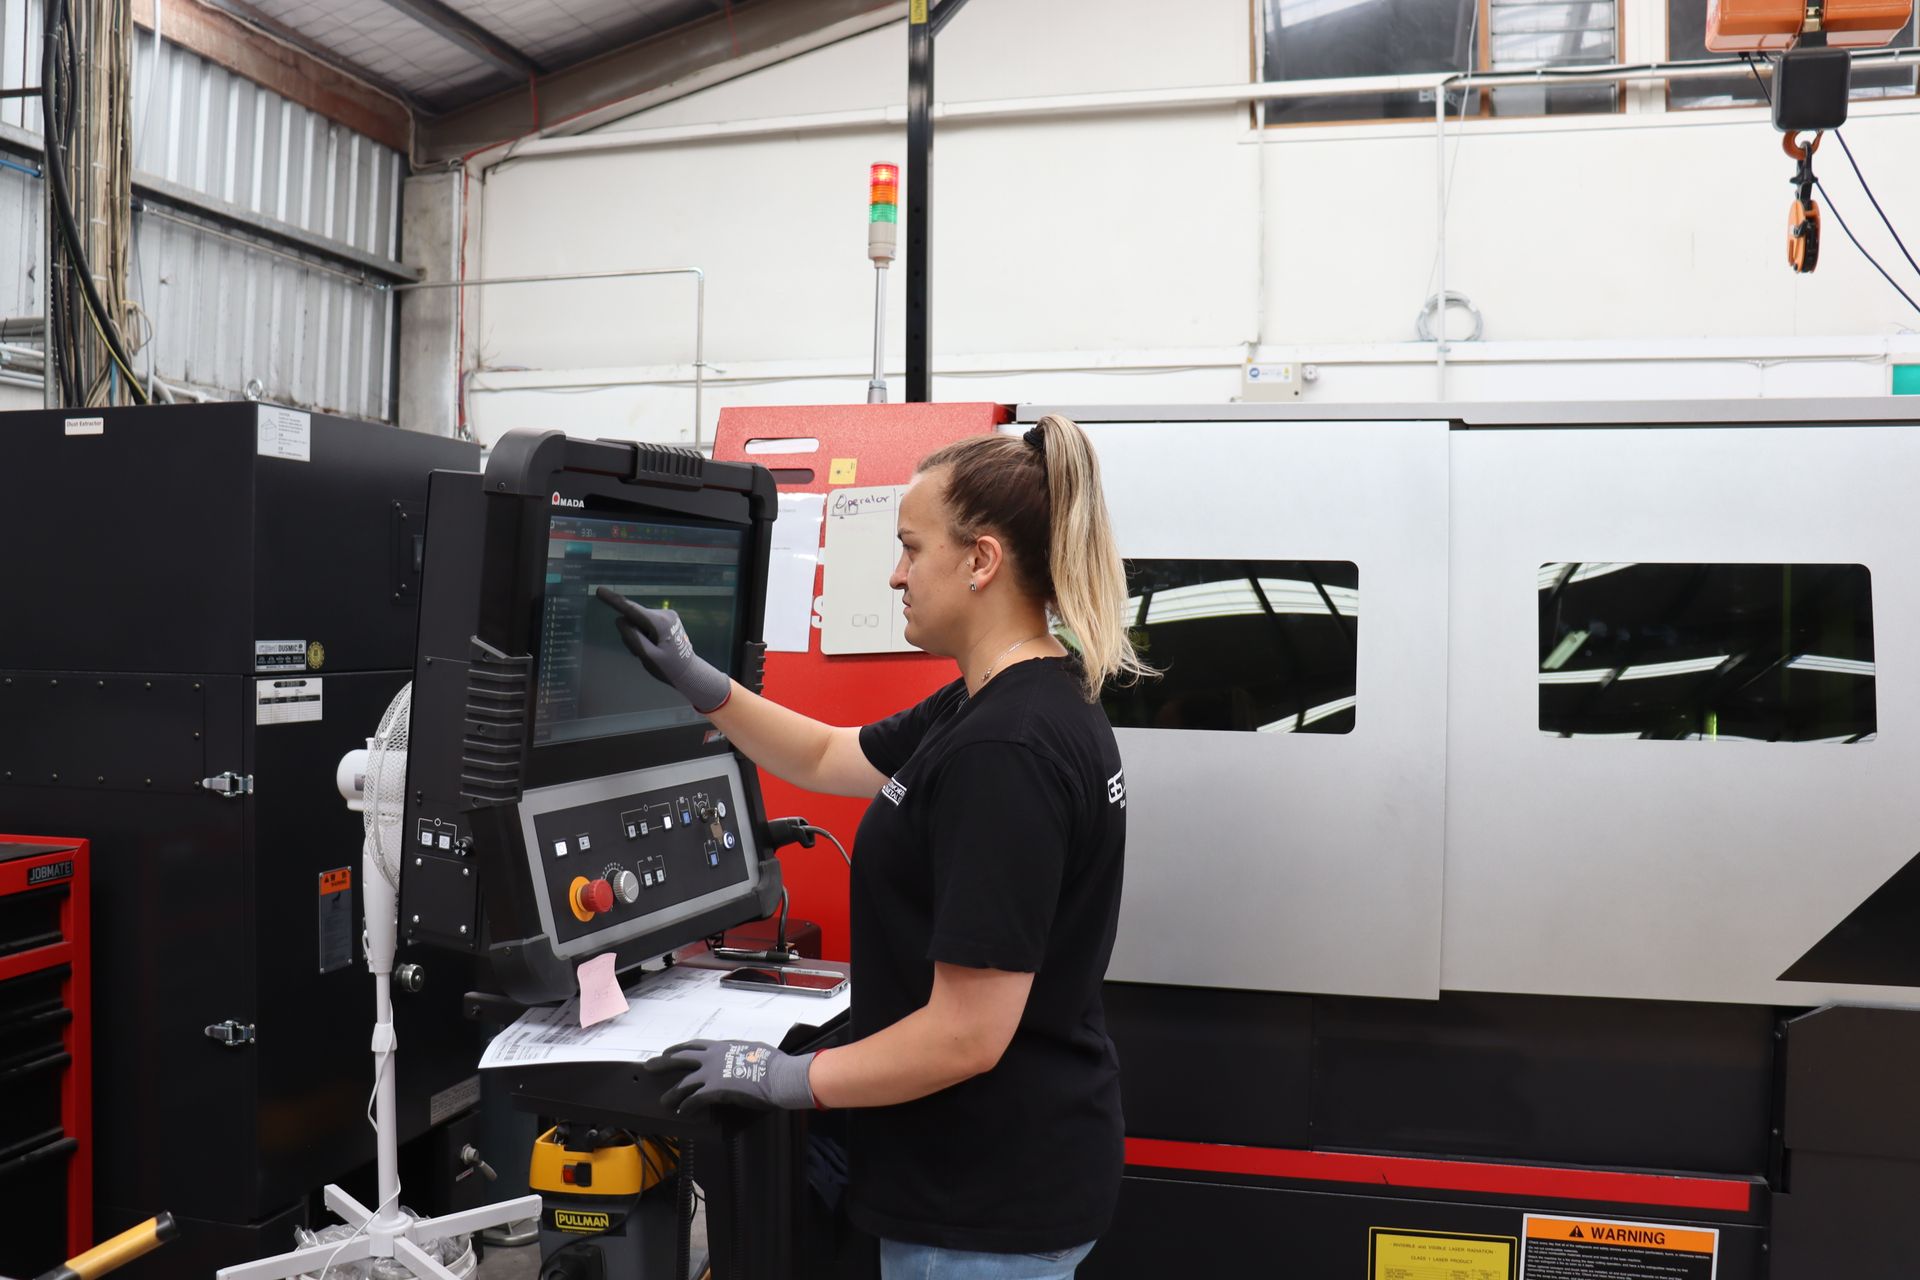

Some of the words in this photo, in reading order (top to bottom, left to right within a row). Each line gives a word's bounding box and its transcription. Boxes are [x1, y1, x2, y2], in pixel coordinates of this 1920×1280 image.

[551, 491, 585, 508] AMADA
[835, 493, 890, 512] Operator
[29, 861, 71, 881] JOBMATE
[722, 1045, 738, 1078] MaxiFlex
[558, 1213, 610, 1228] PULLMAN
[1591, 1226, 1665, 1245] WARNING
